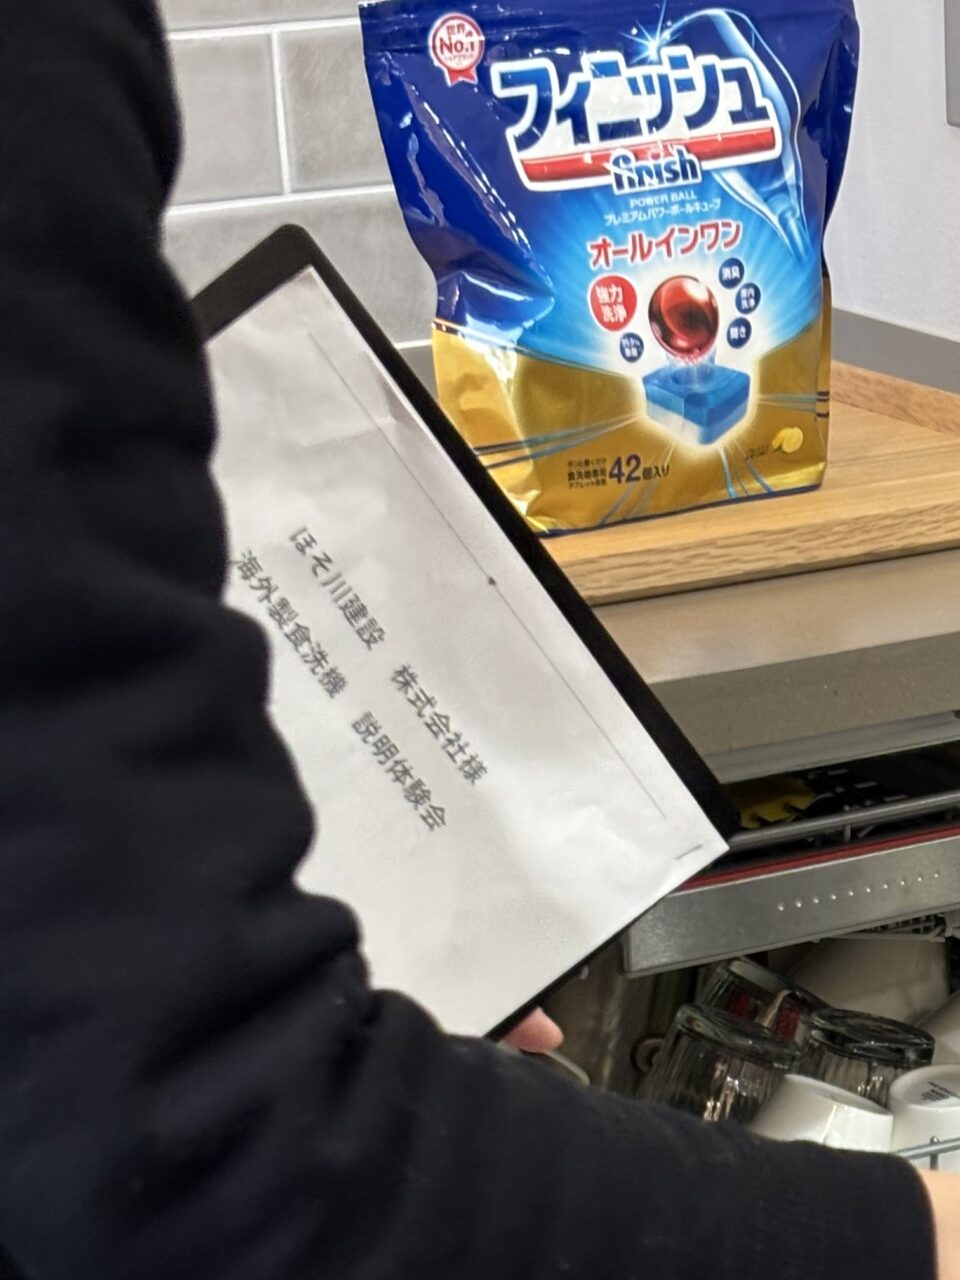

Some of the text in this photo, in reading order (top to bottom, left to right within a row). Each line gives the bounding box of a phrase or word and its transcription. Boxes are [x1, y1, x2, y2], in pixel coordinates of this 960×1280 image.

[439, 36, 475, 55] No.1
[498, 52, 772, 153] フィニッシュ
[611, 147, 700, 191] finish
[630, 190, 697, 208] POWER BALL
[590, 221, 741, 268] オールインワン
[595, 283, 623, 304] 強力
[601, 304, 627, 323] 洗浄
[609, 453, 670, 485] 42個入り
[289, 526, 488, 786] ほそ川建設 株式会社様
[236, 549, 447, 832] 海外製食洗機 説明体験会
